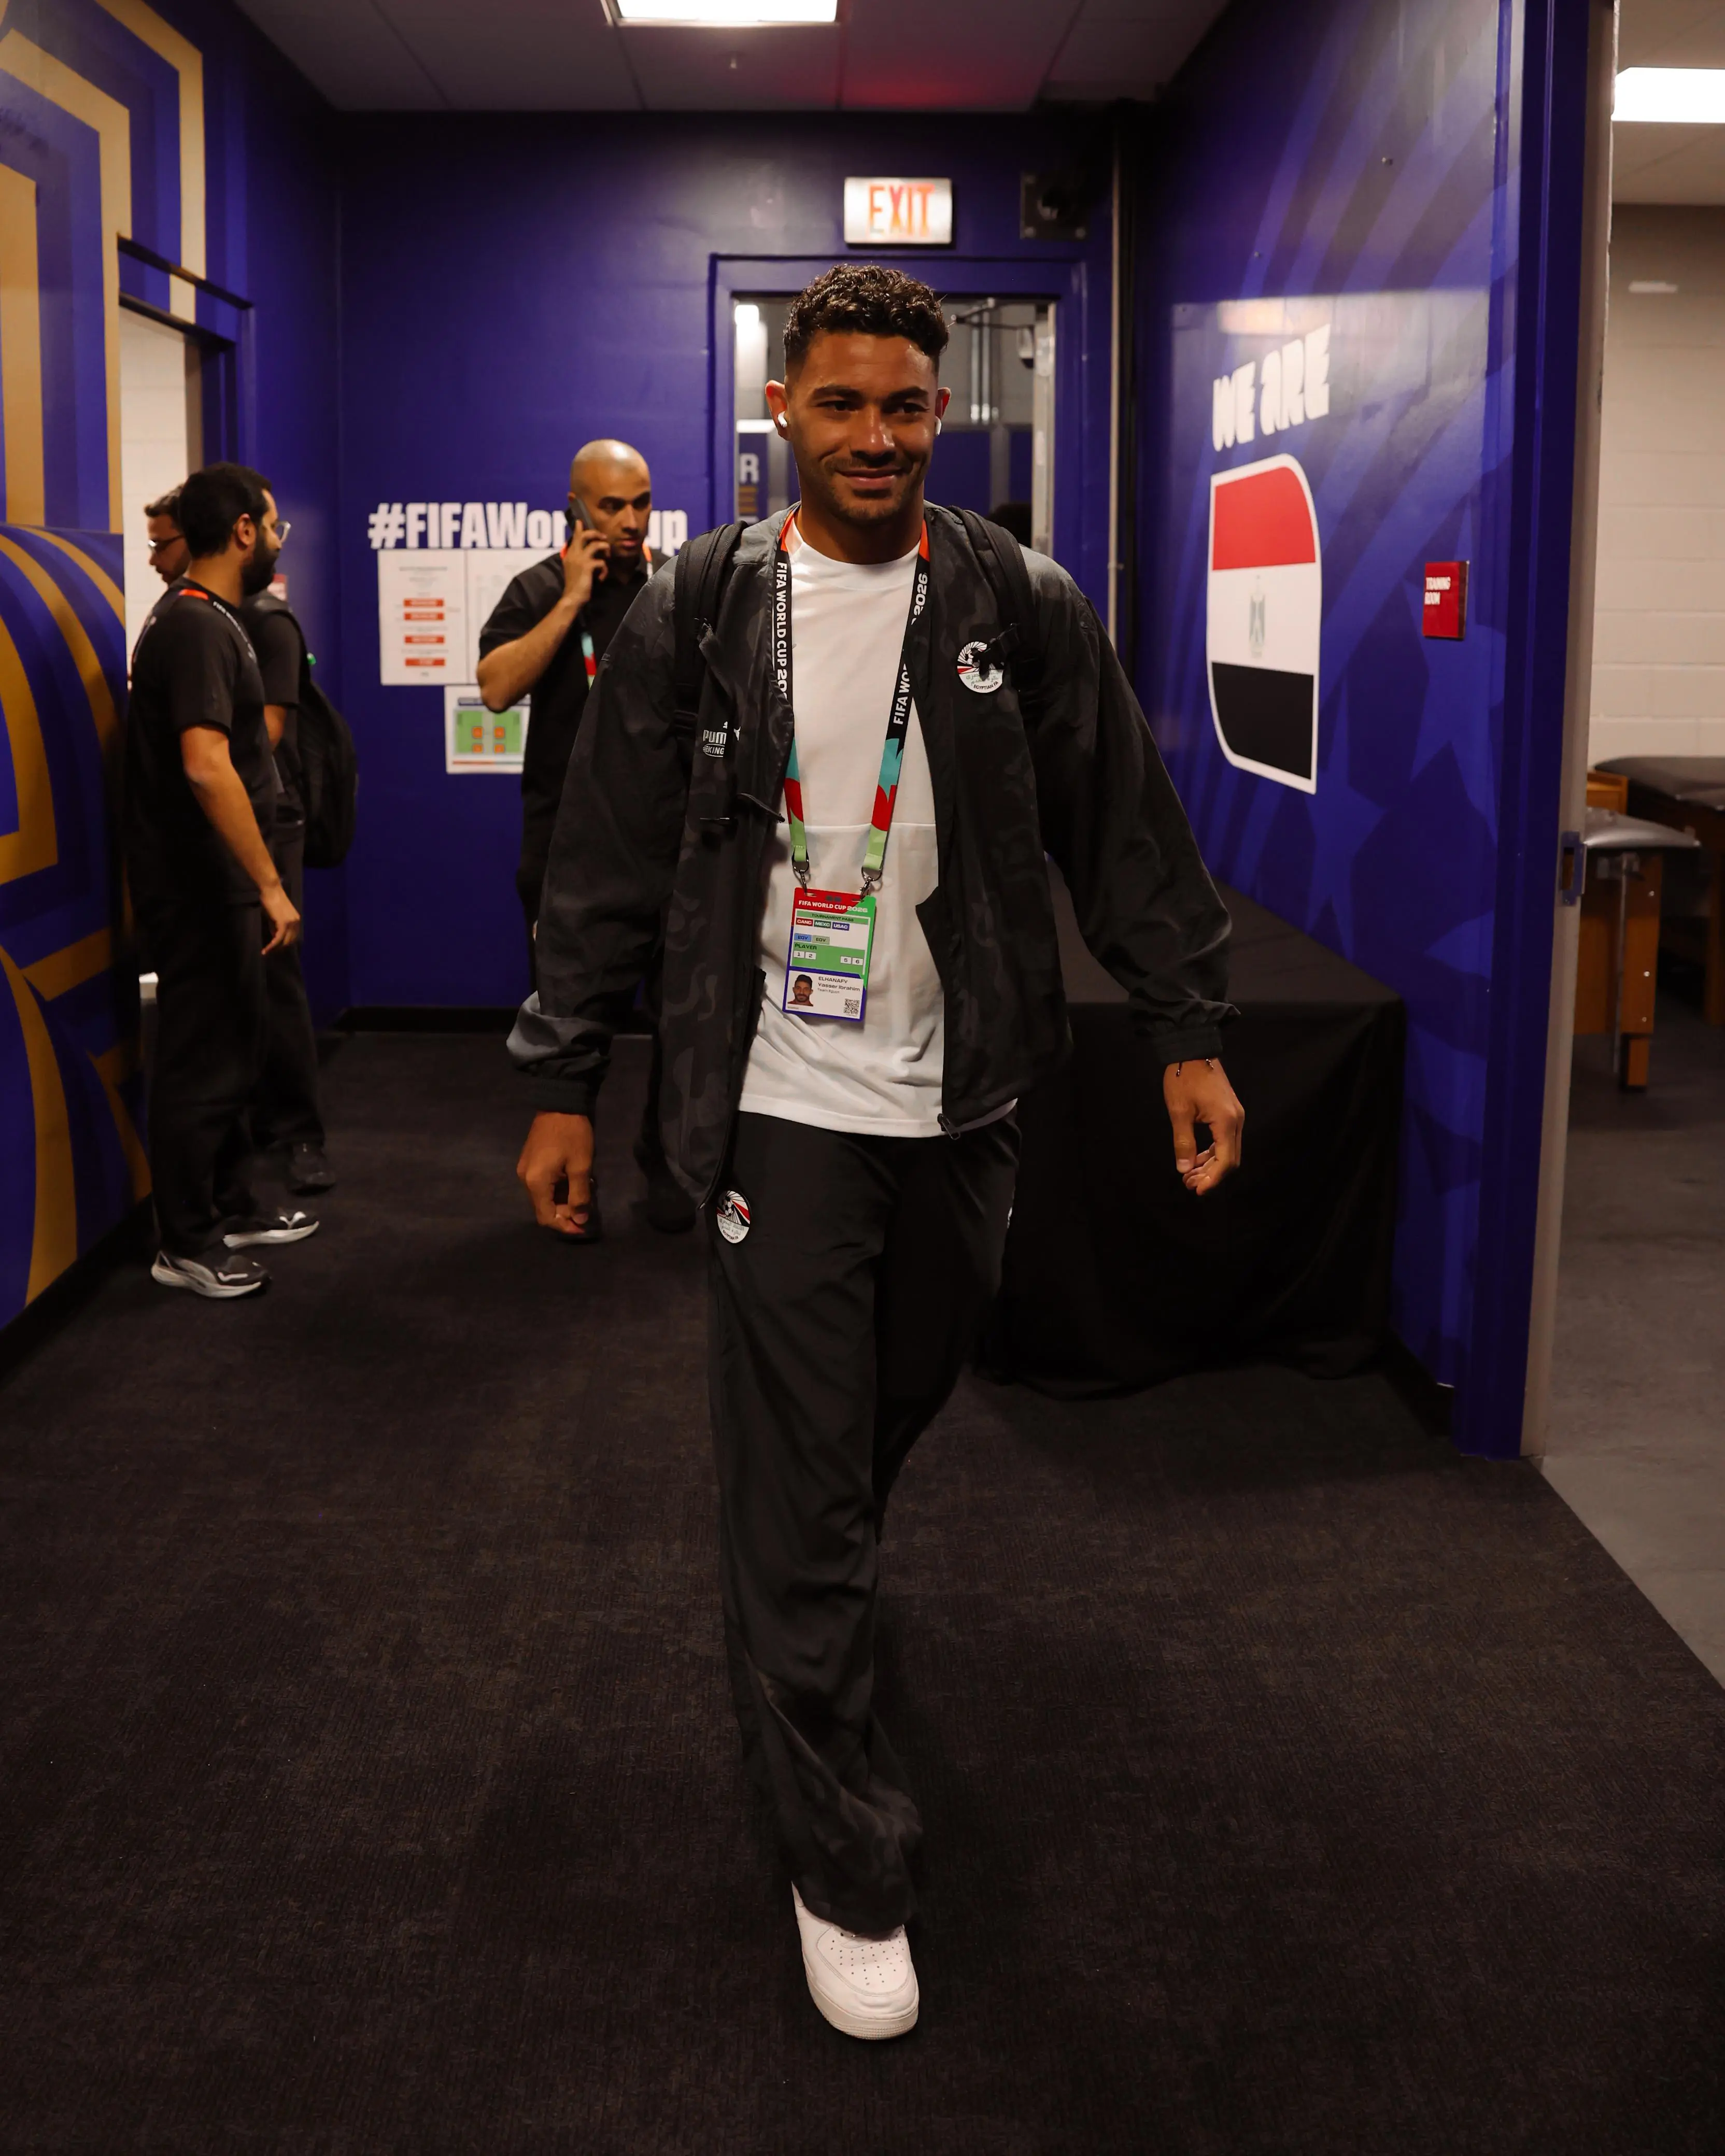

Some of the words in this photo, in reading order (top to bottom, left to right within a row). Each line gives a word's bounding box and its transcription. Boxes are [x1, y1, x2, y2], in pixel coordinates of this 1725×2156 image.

[869, 183, 935, 237] EXIT
[1212, 361, 1256, 452] WE
[1260, 323, 1331, 436] ARE
[367, 502, 688, 557] #FIFAWorup
[776, 562, 787, 589] FIFA
[913, 572, 928, 616] 2026
[776, 590, 787, 639] WORLD
[776, 640, 787, 667] CUP
[777, 669, 788, 700] 20
[899, 663, 911, 693] WO
[893, 696, 908, 725] FIFA
[703, 729, 727, 744] PUM
[708, 746, 725, 755] KING
